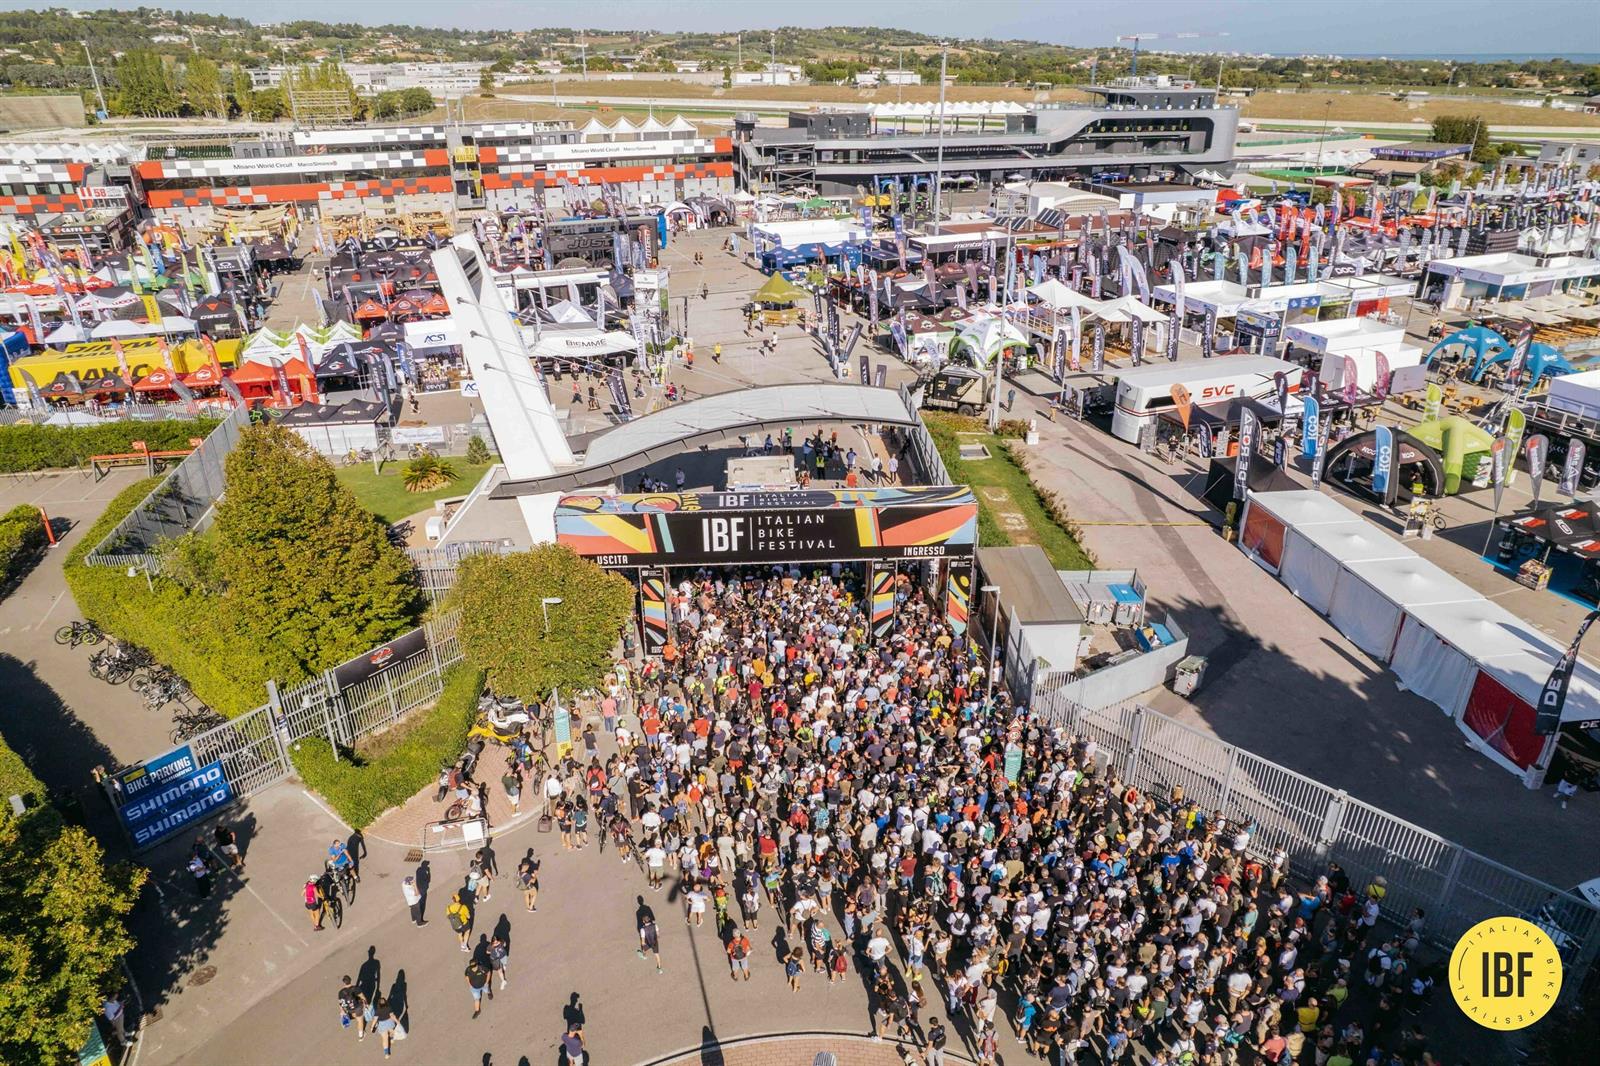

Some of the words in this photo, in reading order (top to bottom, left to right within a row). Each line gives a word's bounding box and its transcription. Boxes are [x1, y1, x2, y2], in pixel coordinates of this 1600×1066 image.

[1202, 384, 1235, 398] SVC
[718, 494, 750, 507] IBF
[758, 514, 825, 526] ITALIAN
[702, 517, 744, 552] IBF
[758, 528, 795, 539] BIKE
[758, 539, 836, 551] FESTIVAL
[903, 545, 945, 556] INGRESSO
[596, 555, 629, 565] USCITA
[126, 775, 150, 794] BIKE
[149, 755, 192, 784] PARKING
[126, 767, 221, 821] SHIMANO
[135, 789, 227, 844] SHIMANO
